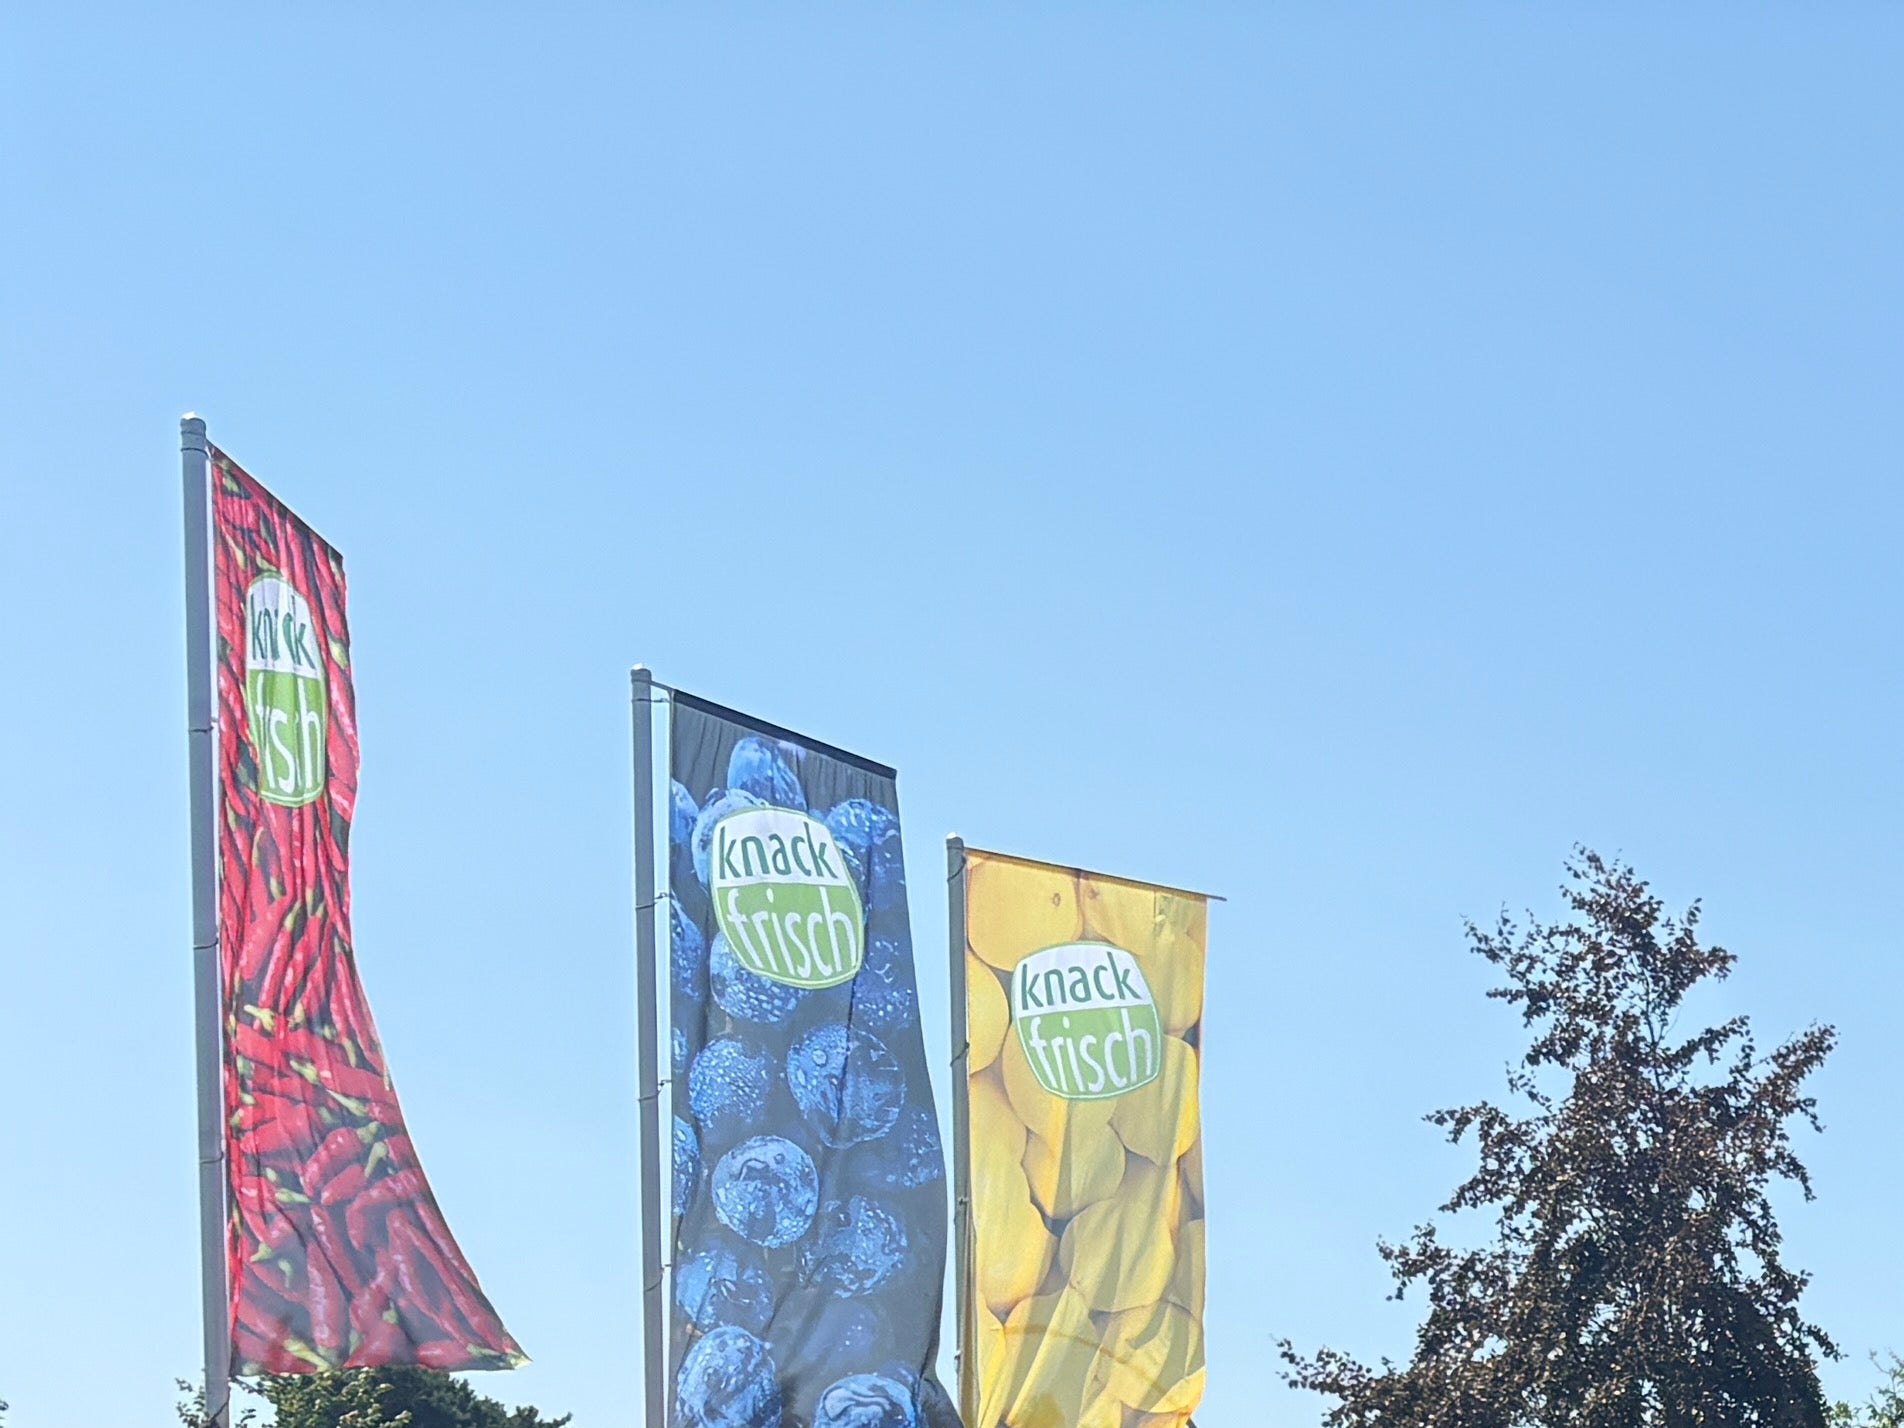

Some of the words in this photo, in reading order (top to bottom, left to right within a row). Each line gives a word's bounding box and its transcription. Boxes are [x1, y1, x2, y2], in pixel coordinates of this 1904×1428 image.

[719, 821, 839, 880] knack
[727, 886, 857, 978] frisch
[1021, 951, 1142, 1010] knack
[1029, 1008, 1151, 1092] frisch
